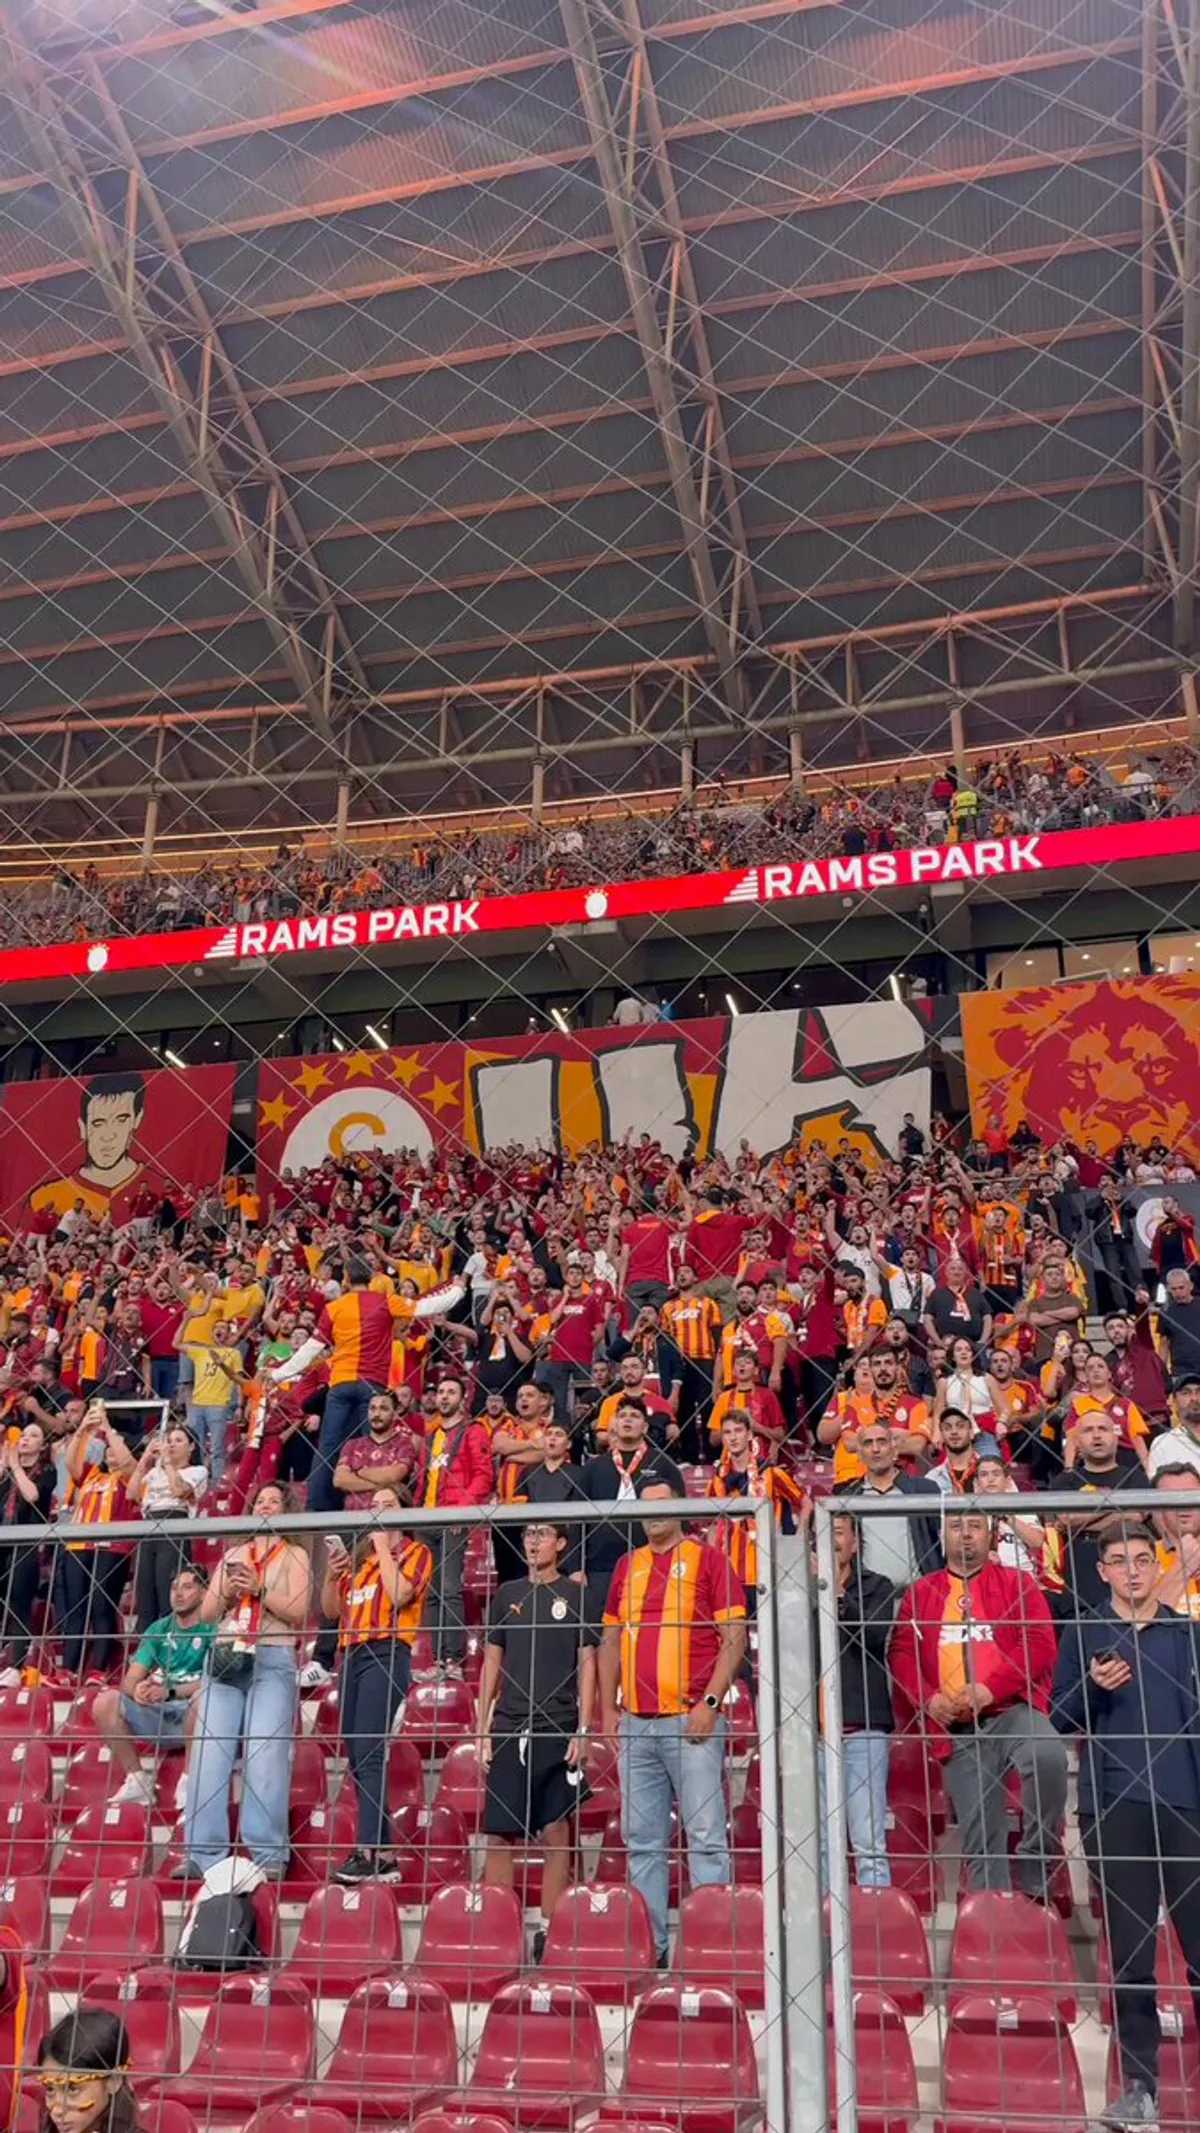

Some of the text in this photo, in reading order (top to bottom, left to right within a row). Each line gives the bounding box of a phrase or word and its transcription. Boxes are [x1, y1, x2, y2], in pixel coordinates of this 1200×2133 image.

[764, 836, 1043, 898] RAMS PARK
[241, 901, 480, 955] RAMS PARK
